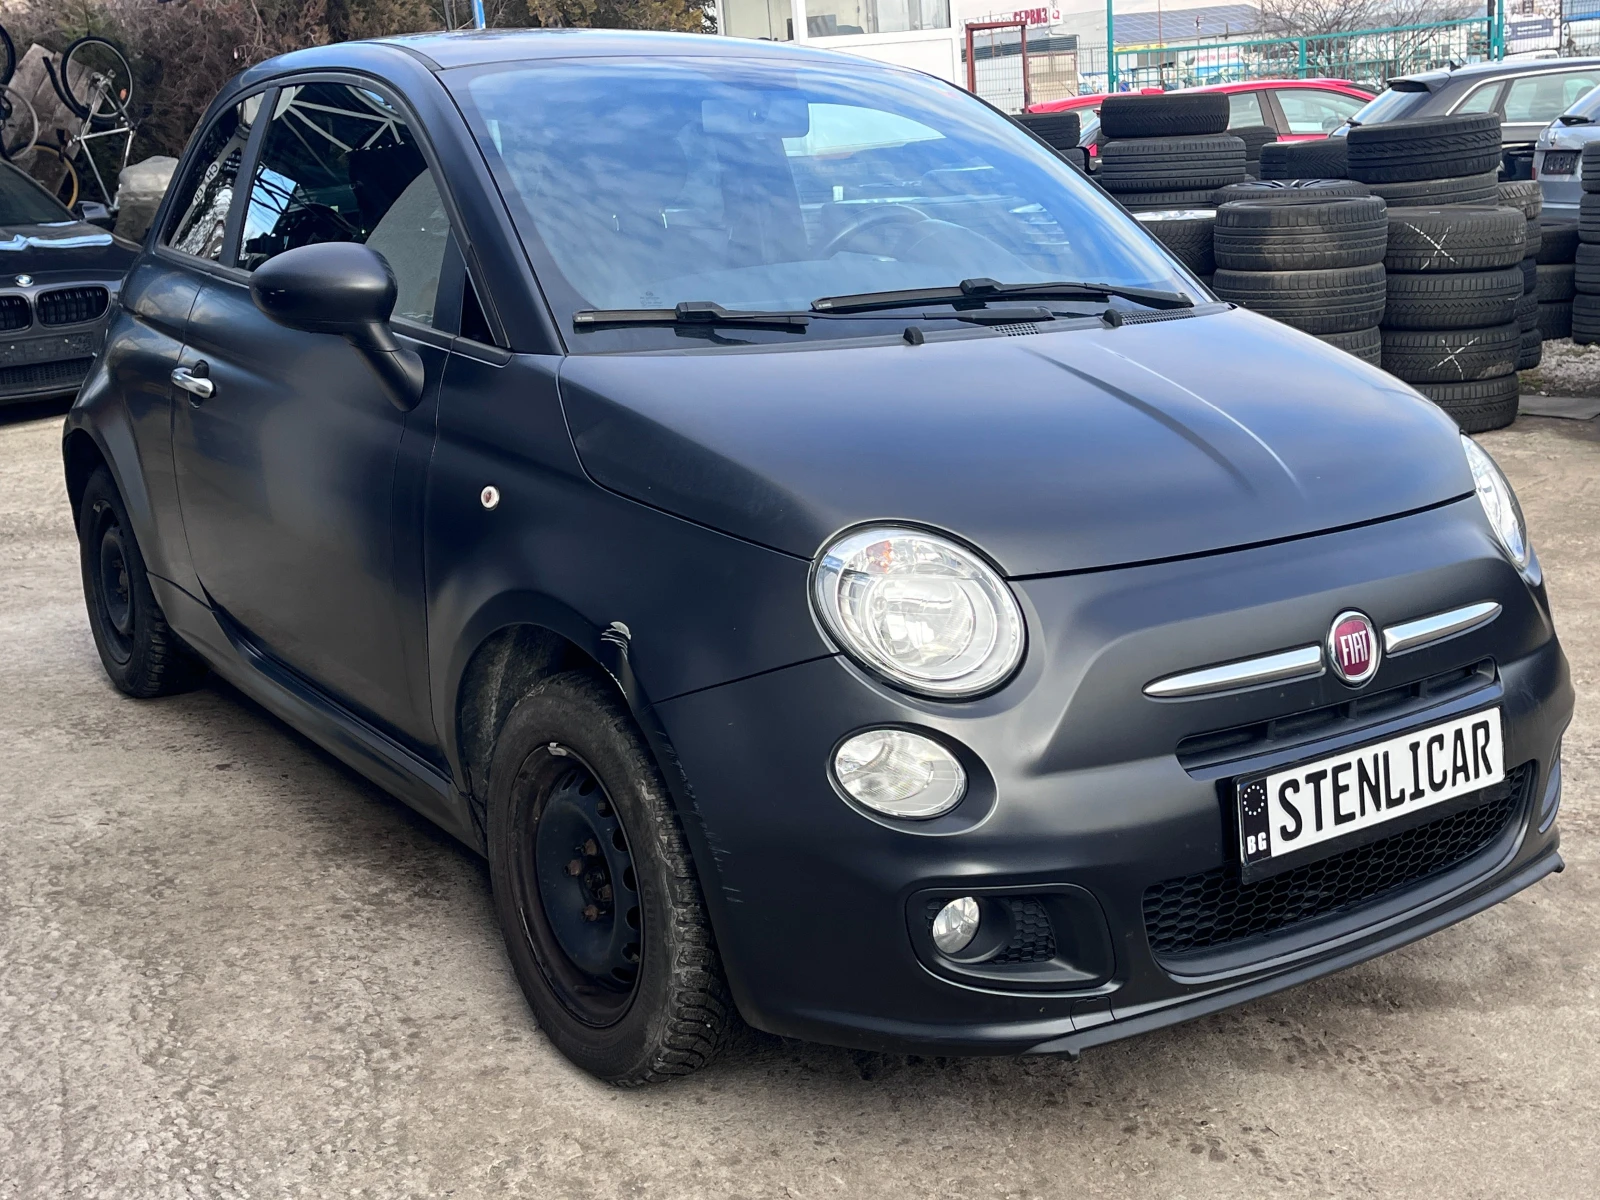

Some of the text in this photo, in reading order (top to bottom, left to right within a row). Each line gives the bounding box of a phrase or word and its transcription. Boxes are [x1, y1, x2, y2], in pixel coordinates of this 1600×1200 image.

[1013, 7, 1048, 25] СЕРВИЗ
[1340, 630, 1368, 667] FIAT
[1277, 719, 1493, 842] STENLICAR
[1246, 831, 1267, 855] BG
